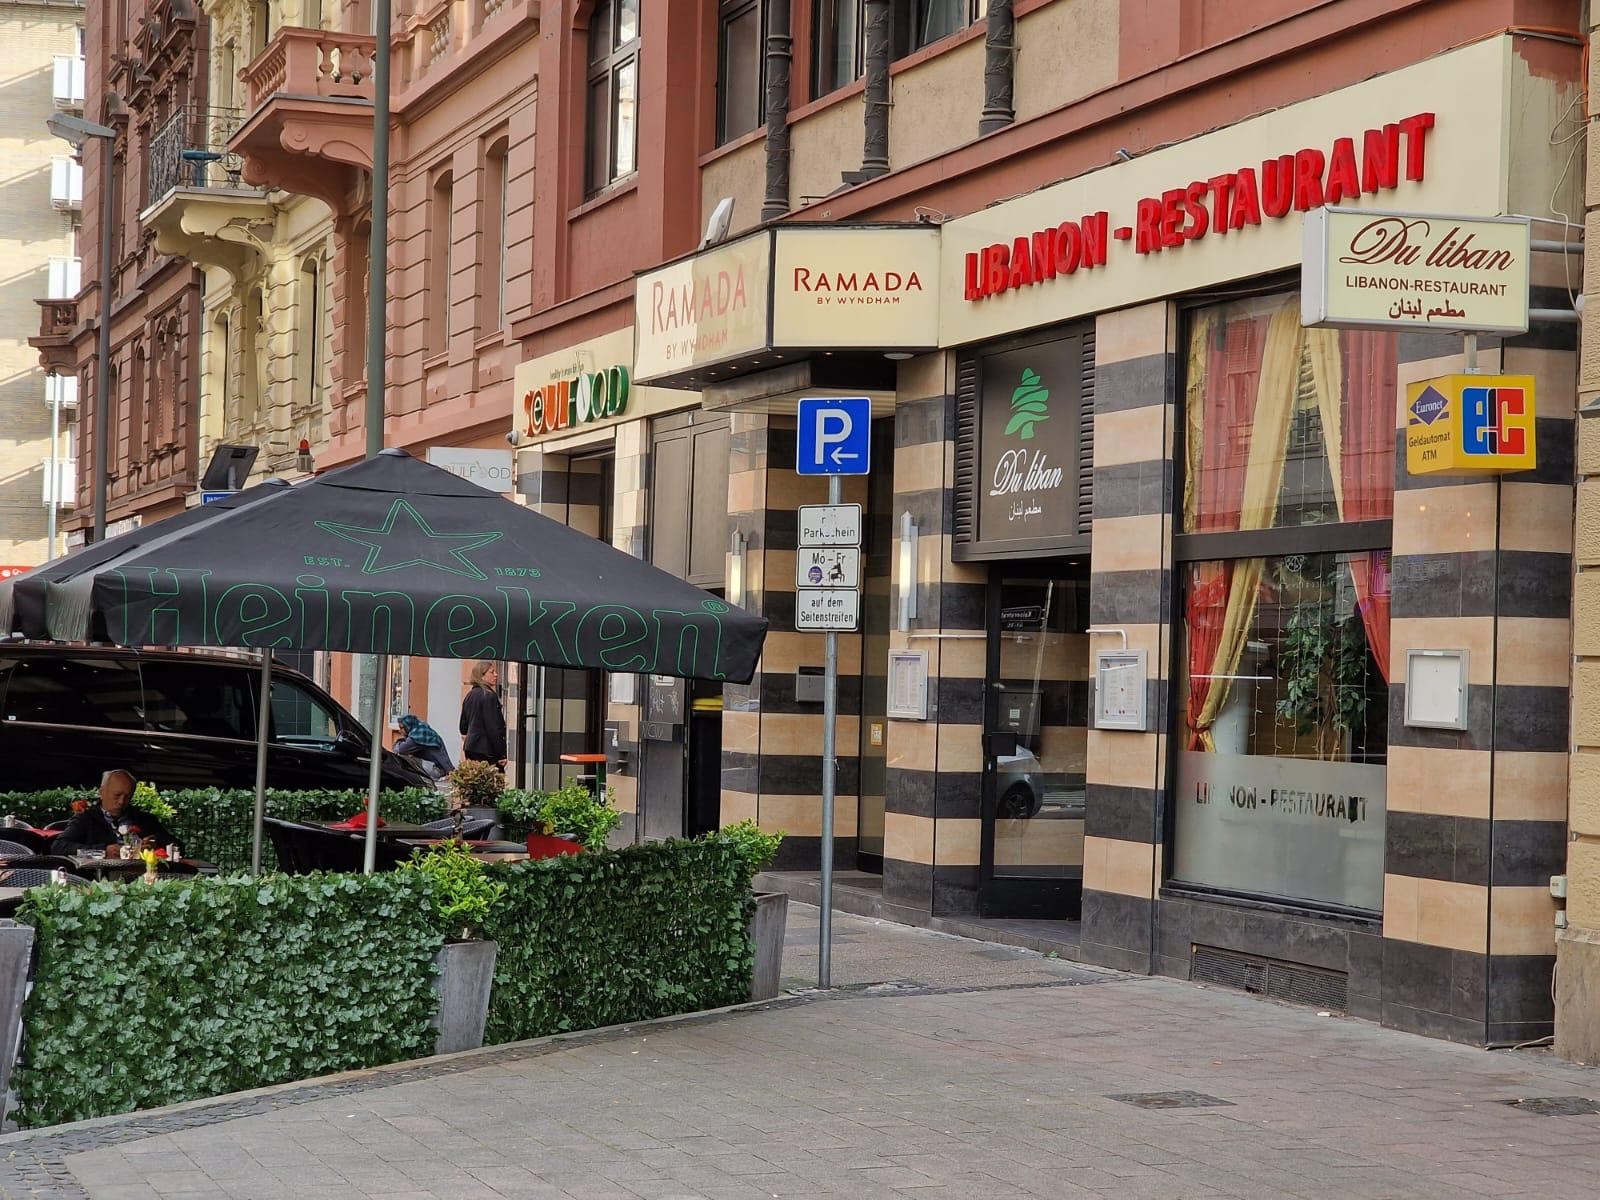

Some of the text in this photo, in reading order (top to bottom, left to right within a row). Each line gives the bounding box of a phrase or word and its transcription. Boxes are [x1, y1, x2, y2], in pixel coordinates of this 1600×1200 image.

[964, 211, 1108, 301] LIBANON
[1135, 112, 1436, 255] RESTAURANT
[1339, 217, 1515, 271] Du liban
[793, 267, 923, 293] RAMADA
[1345, 275, 1507, 297] LIBANON-RESTAURANT
[651, 264, 748, 336] RAMADA
[816, 296, 901, 305] BY WYNDHAM
[1388, 298, 1466, 323] مطعم لبنان
[666, 328, 729, 360] BY WYNDHAM
[1415, 400, 1444, 414] Euronet
[814, 408, 853, 465] P
[1408, 431, 1451, 448] Geldautomat
[1421, 449, 1438, 461] ATM
[989, 448, 1063, 496] Du liban
[1023, 498, 1042, 521] مطعم
[303, 555, 351, 568] EST.
[812, 553, 826, 564] Mo
[836, 553, 845, 564] Fr
[495, 567, 542, 577] 1873
[811, 596, 843, 608] auf dem
[110, 566, 728, 680] Heineken
[800, 611, 854, 622] Seitenstreifen
